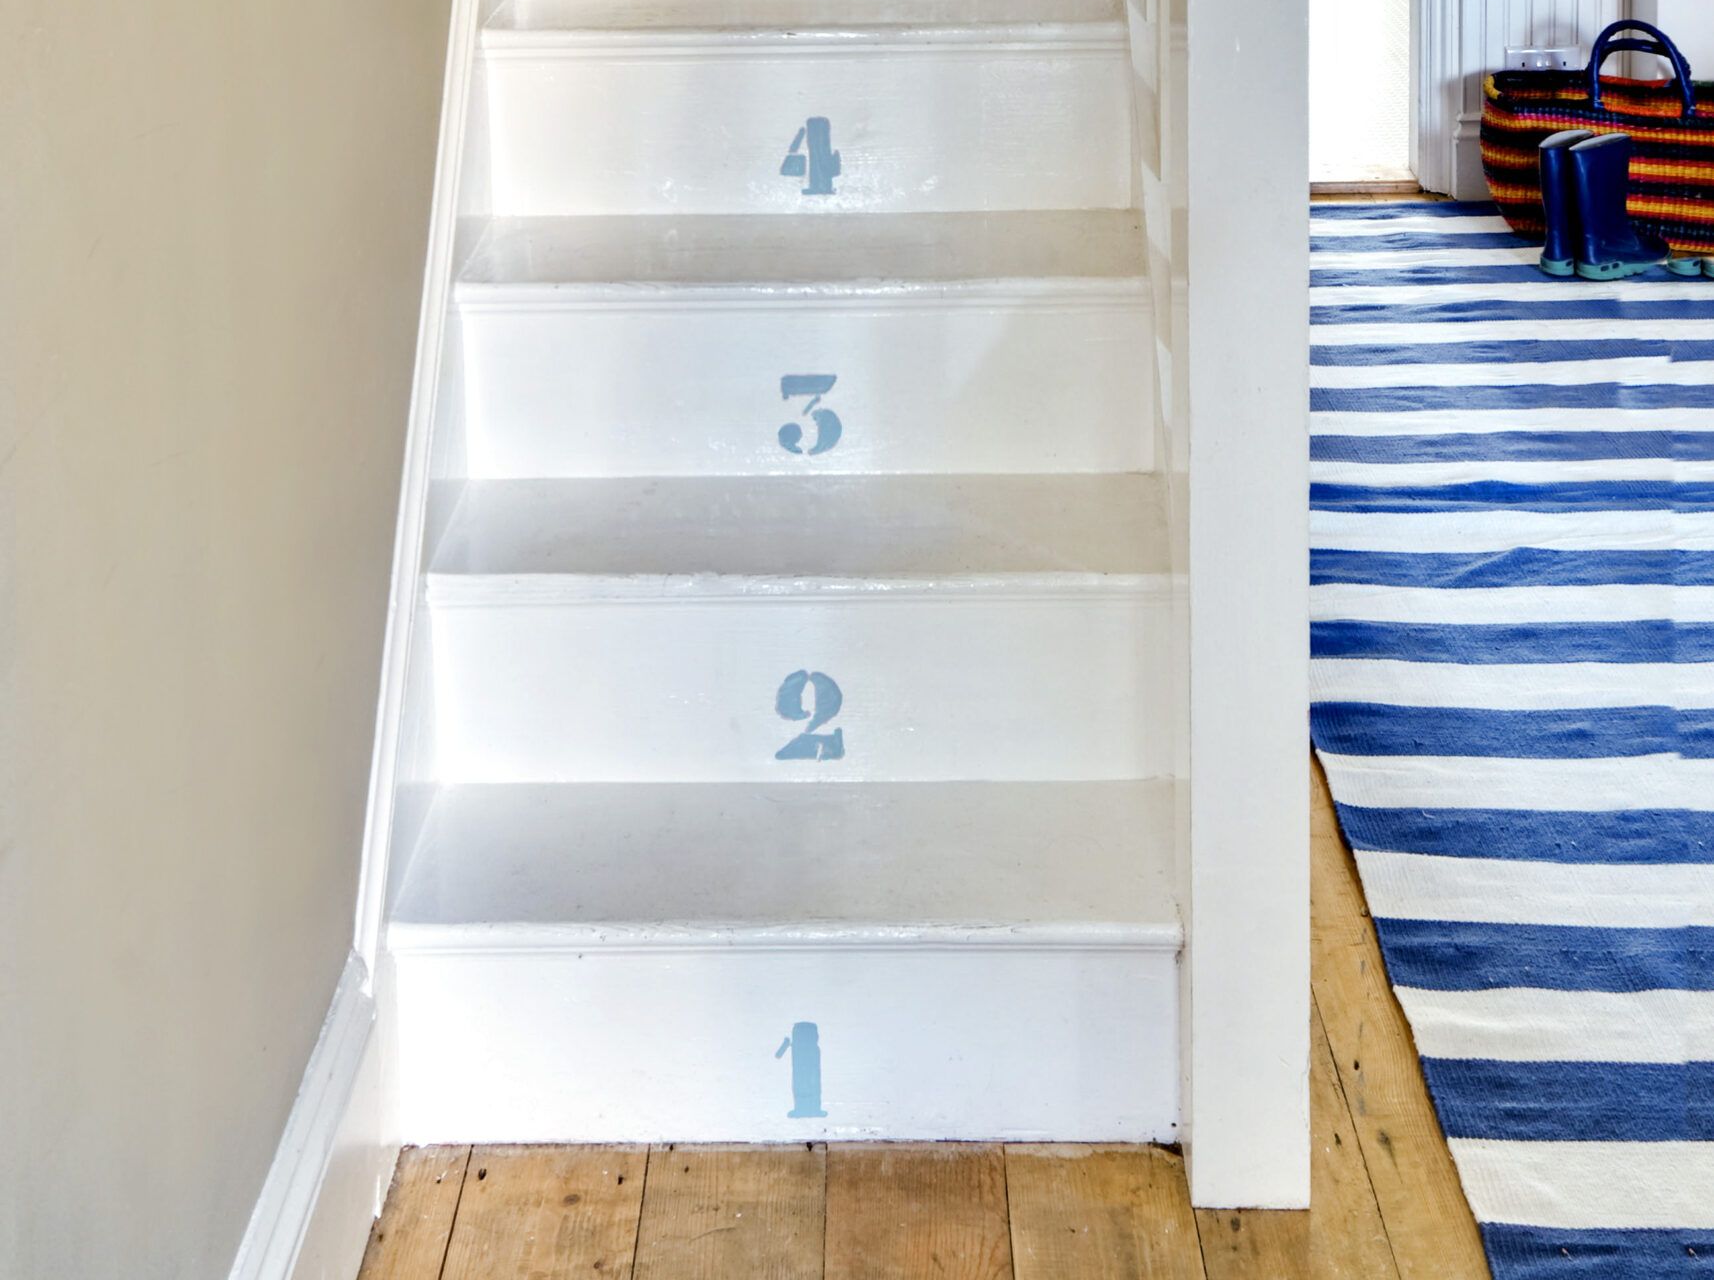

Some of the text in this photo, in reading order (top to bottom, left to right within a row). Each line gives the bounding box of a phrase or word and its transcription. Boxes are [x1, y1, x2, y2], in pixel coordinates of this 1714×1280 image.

[779, 115, 843, 198] 4
[777, 373, 843, 458] 3
[774, 668, 846, 762] 2
[774, 1020, 829, 1120] 1
